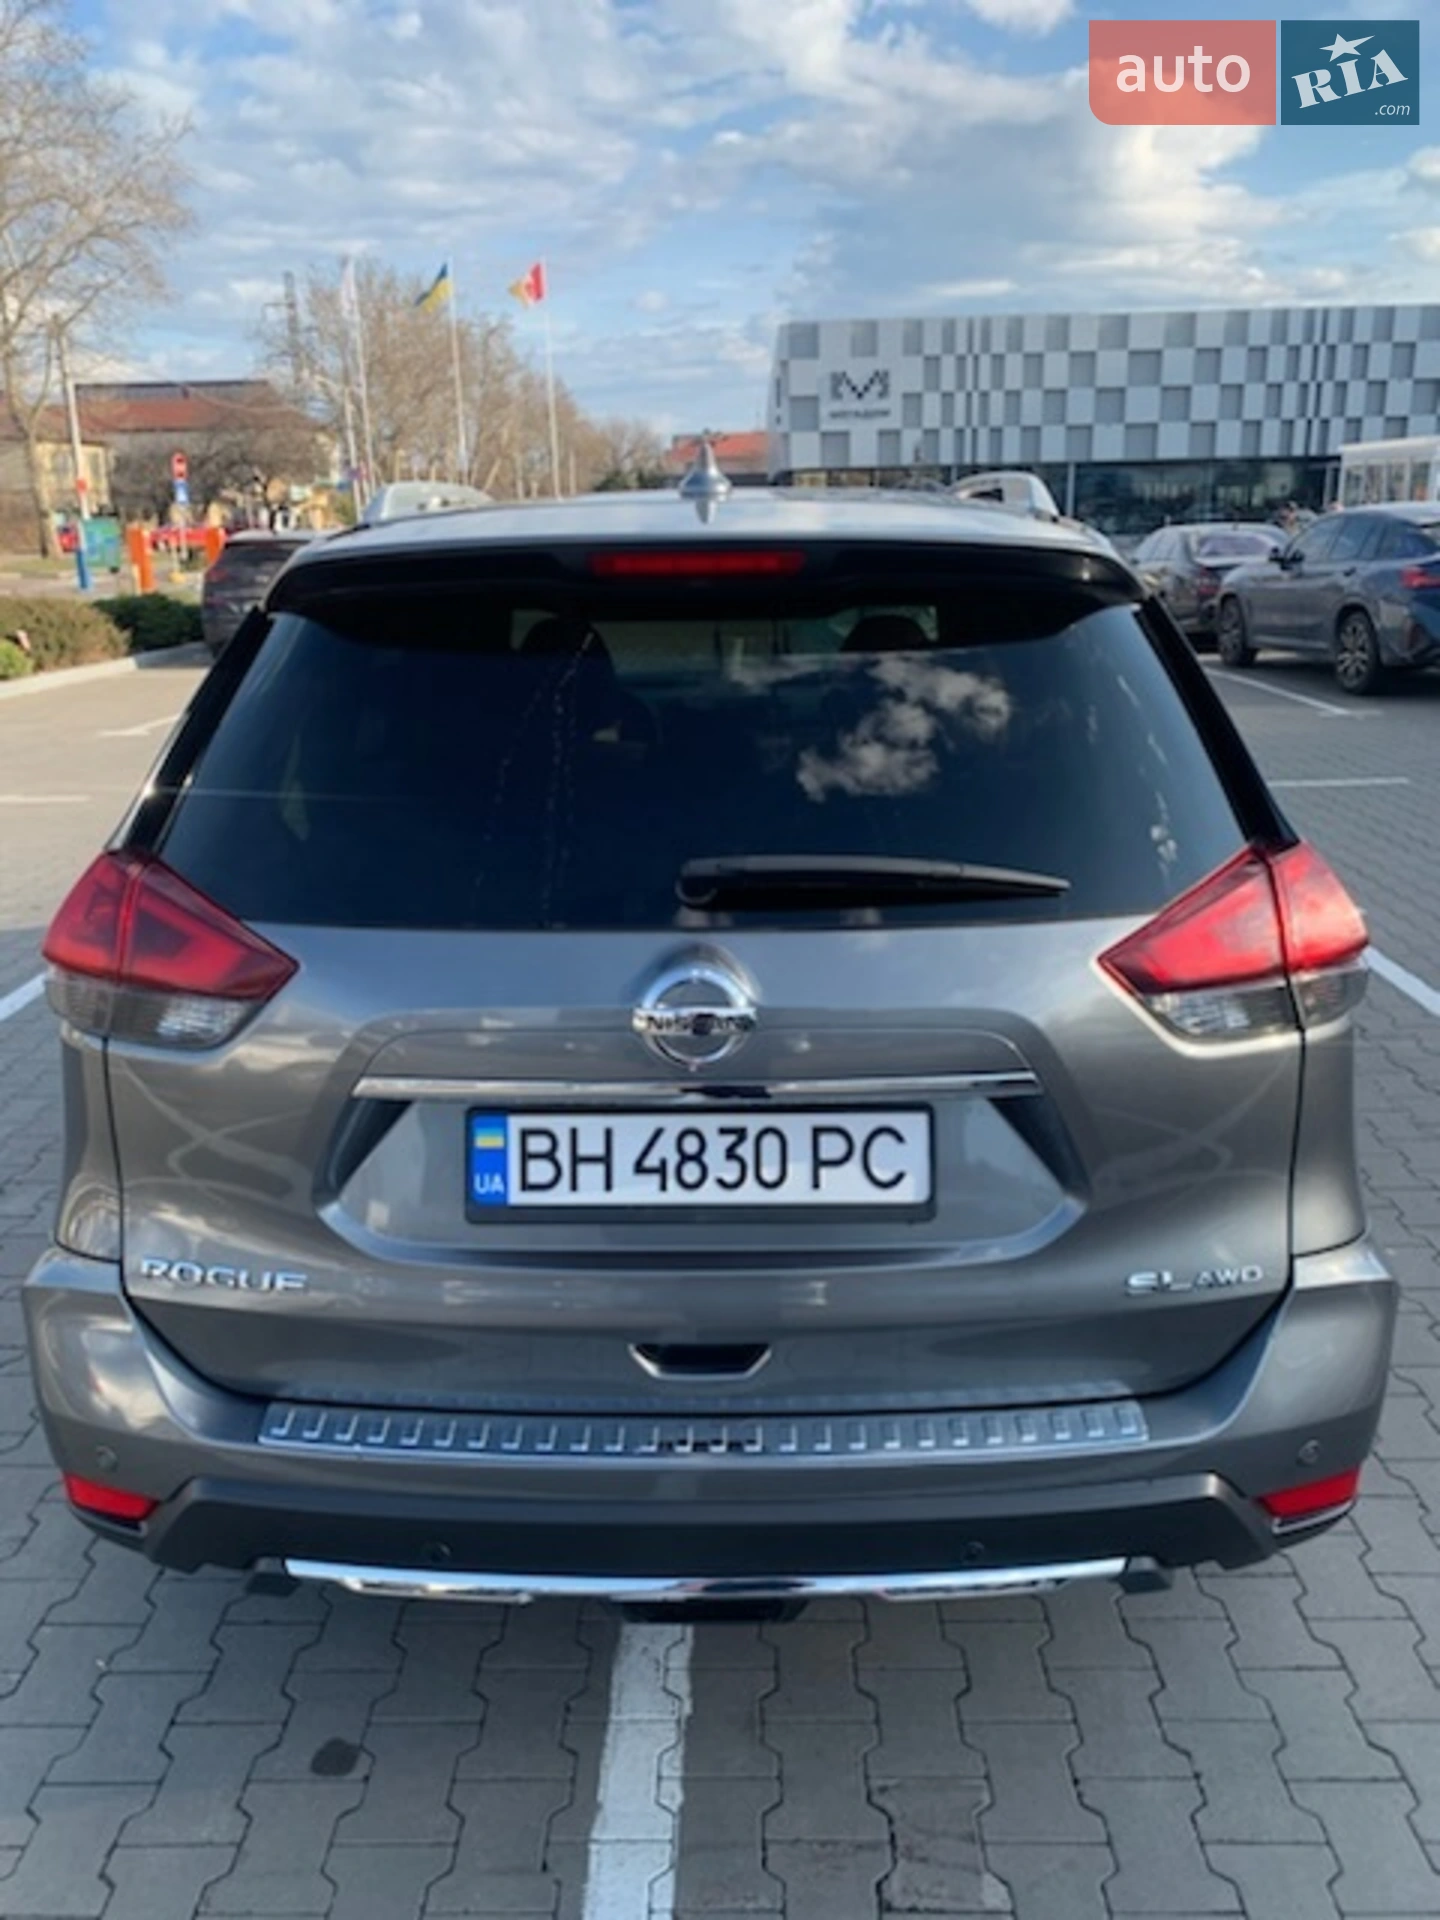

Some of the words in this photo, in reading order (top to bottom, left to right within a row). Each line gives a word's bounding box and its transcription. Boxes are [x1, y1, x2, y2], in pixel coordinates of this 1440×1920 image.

[642, 1013, 755, 1034] NISAN
[519, 1127, 613, 1192] BH
[633, 1127, 789, 1191] 4830
[811, 1127, 907, 1190] PC
[474, 1174, 505, 1194] UA
[139, 1258, 309, 1293] ROGUE
[1197, 1264, 1264, 1287] AWD
